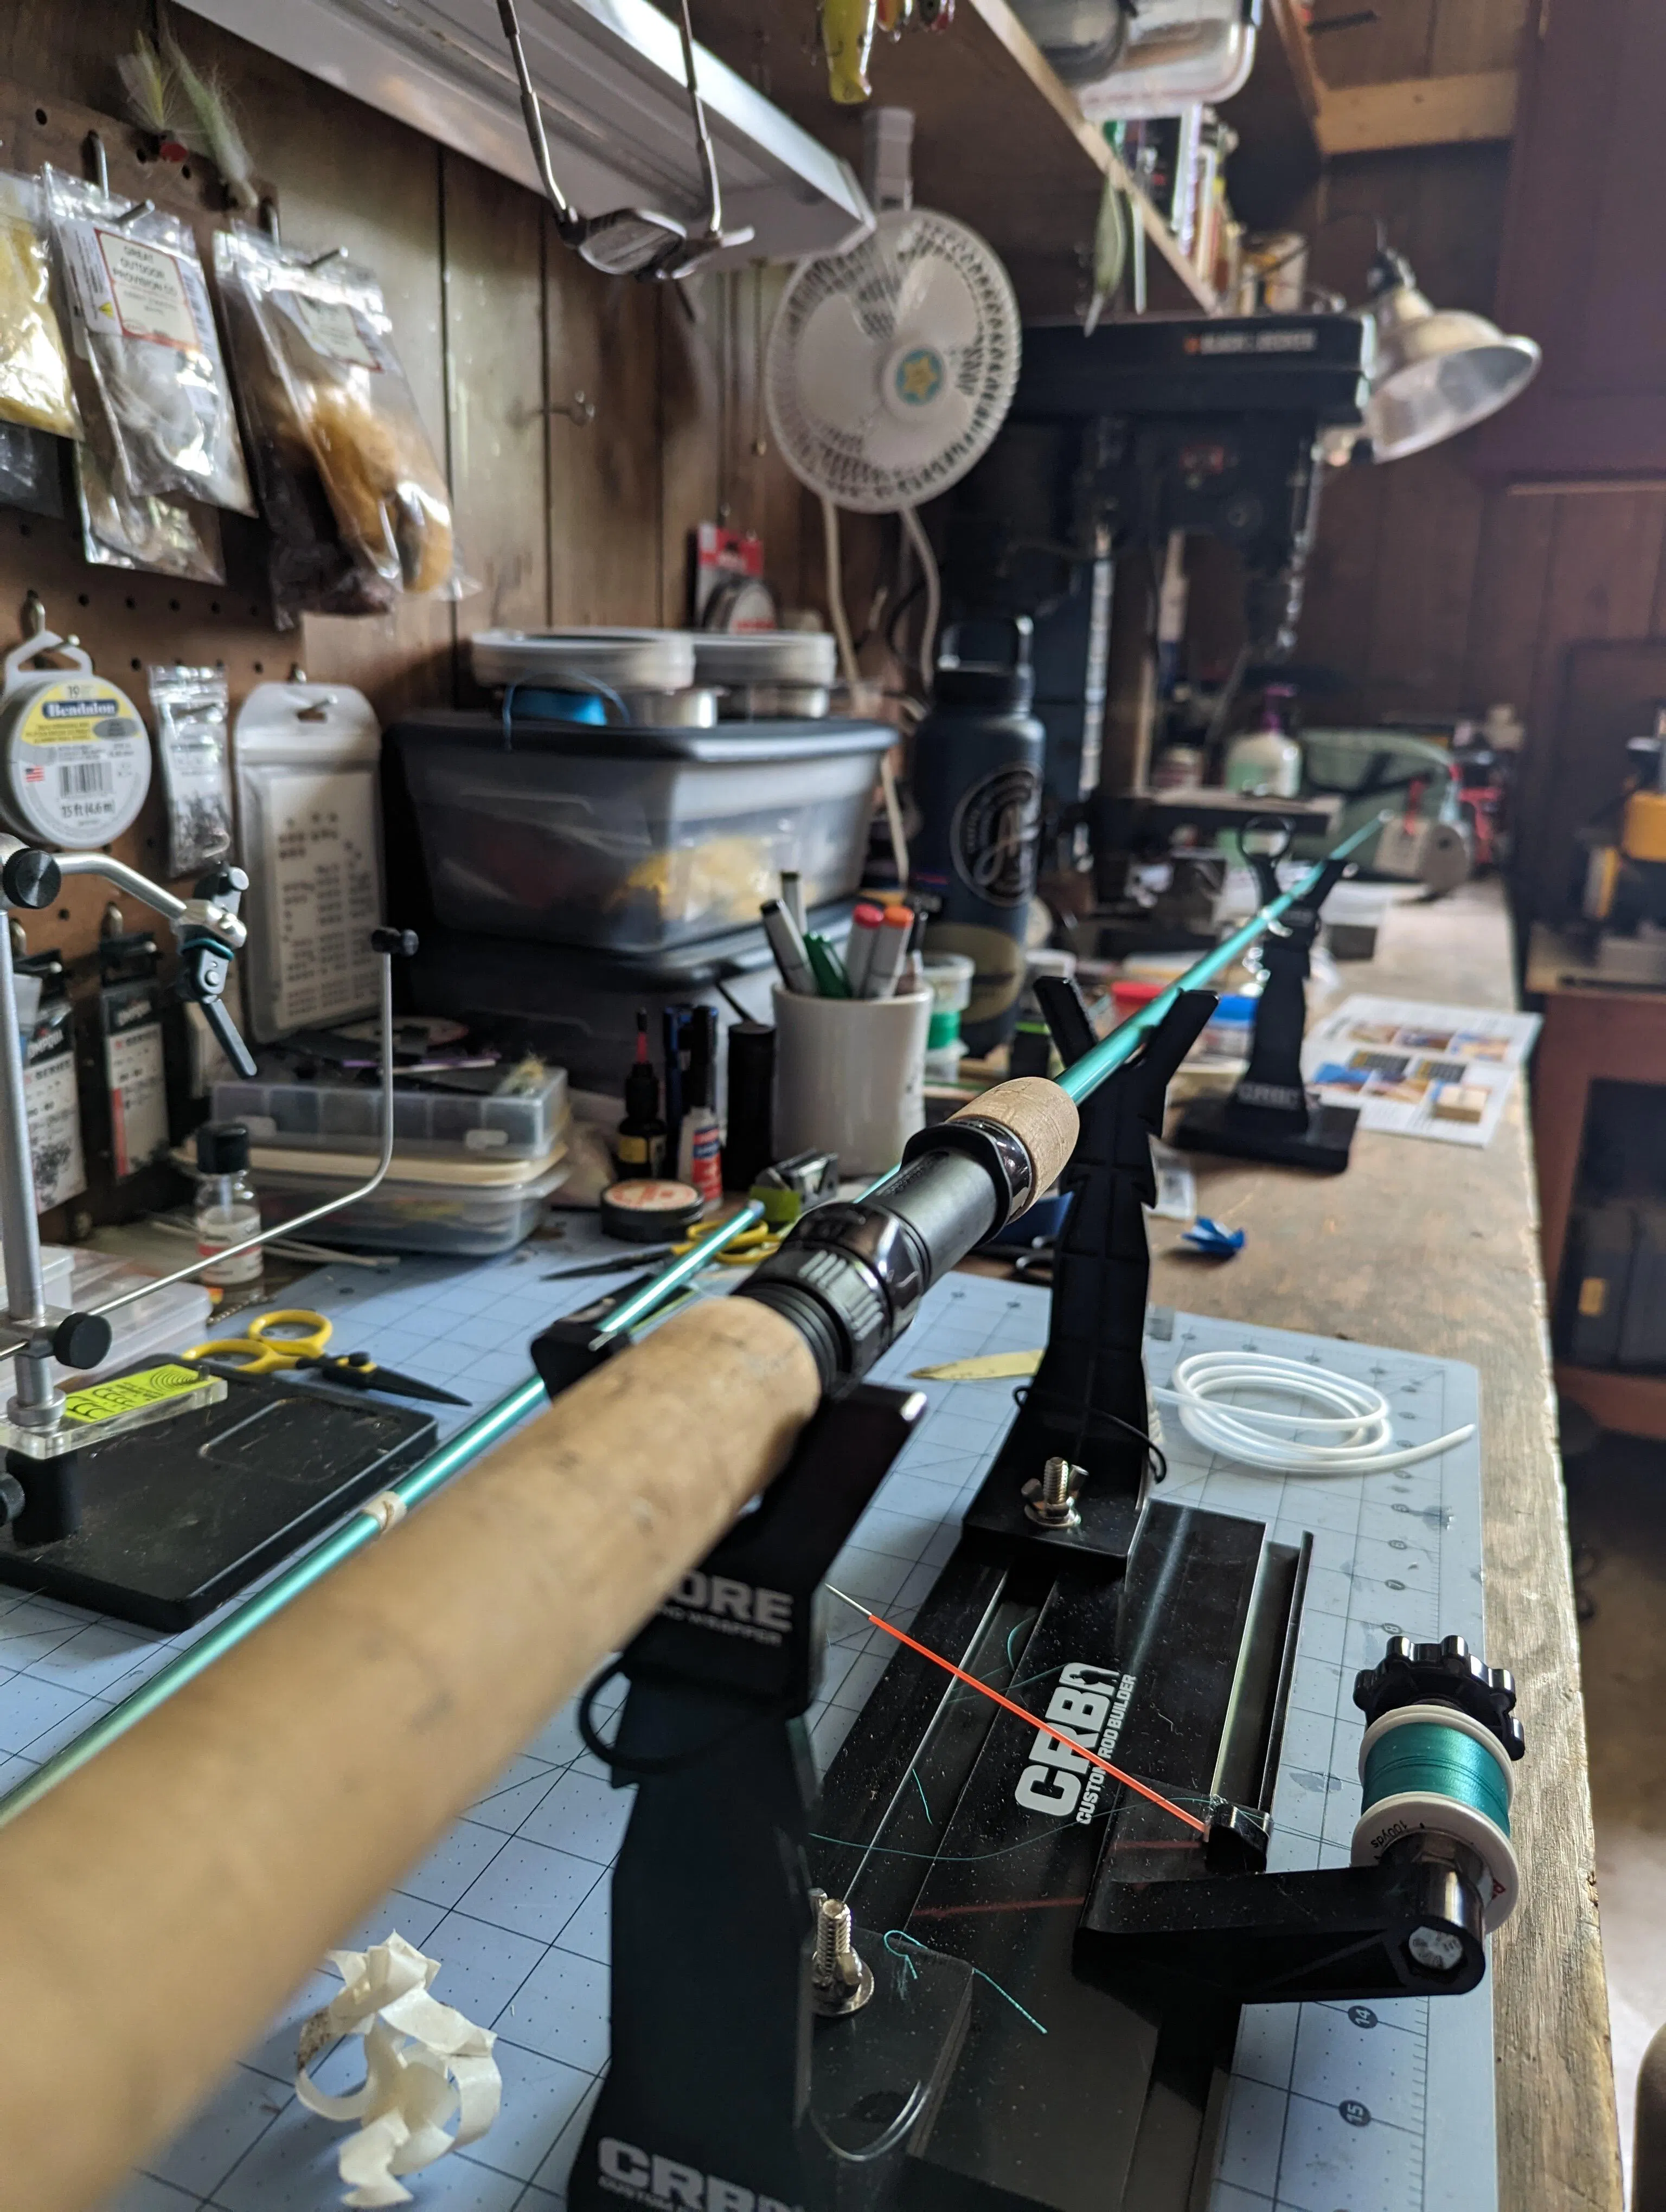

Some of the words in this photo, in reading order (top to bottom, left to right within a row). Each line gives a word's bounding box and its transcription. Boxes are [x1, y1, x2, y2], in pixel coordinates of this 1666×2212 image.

[48, 702, 116, 718] Beadalon
[1107, 1674, 1136, 1730] BUILDER
[1097, 1728, 1119, 1759] ROD
[1354, 2008, 1372, 2025] 14
[1345, 2103, 1363, 2123] 15
